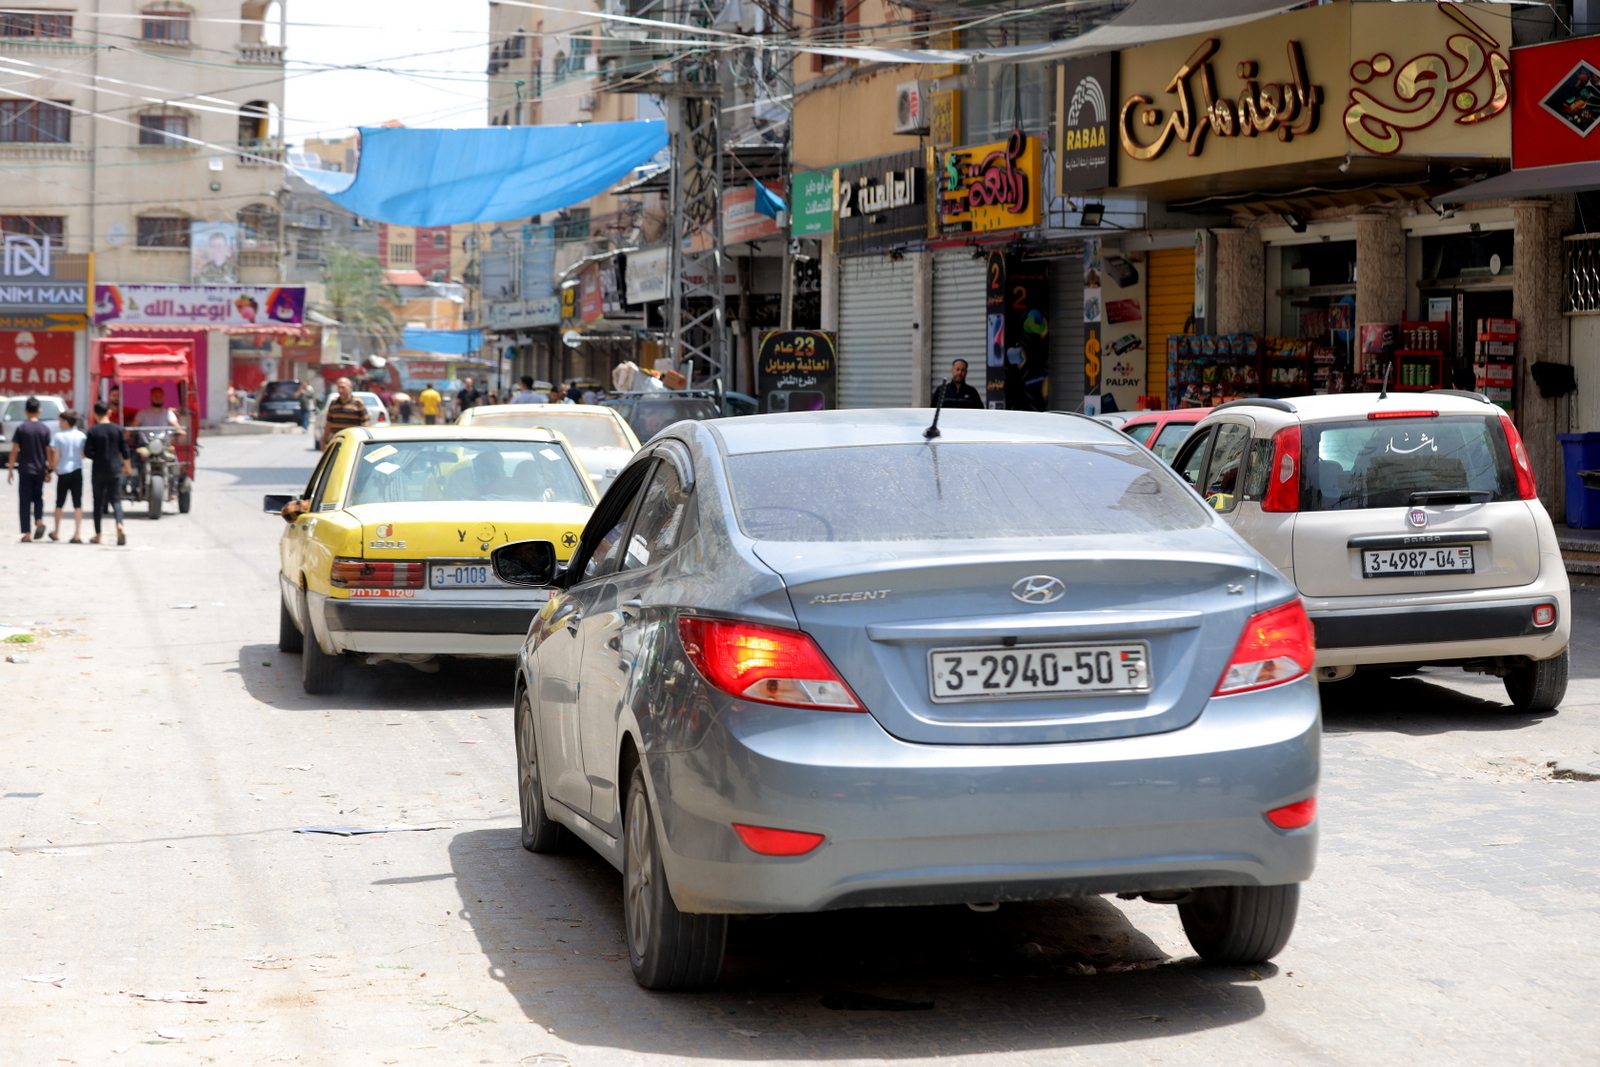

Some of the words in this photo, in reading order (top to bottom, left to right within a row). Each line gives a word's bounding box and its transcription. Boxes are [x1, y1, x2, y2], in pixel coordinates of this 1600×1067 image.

[1119, 38, 1232, 161] ماركت
[1066, 125, 1106, 151] RABAA
[840, 180, 852, 218] 2
[991, 263, 1000, 289] 2
[37, 288, 84, 303] MAN
[1012, 286, 1027, 309] 2
[14, 318, 44, 328] MAN
[774, 340, 793, 355] عام
[794, 336, 815, 356] 23
[765, 358, 796, 374] موبايل
[797, 357, 829, 374] العالمية
[1106, 378, 1139, 387] PALPAY
[1369, 550, 1456, 571] 3-4987-04
[1462, 559, 1468, 568] P
[349, 588, 381, 597] מרחק
[385, 588, 414, 597] שמור
[808, 588, 892, 606] ACCENT
[942, 650, 1114, 692] 3-2940-50
[1126, 668, 1139, 686] P
